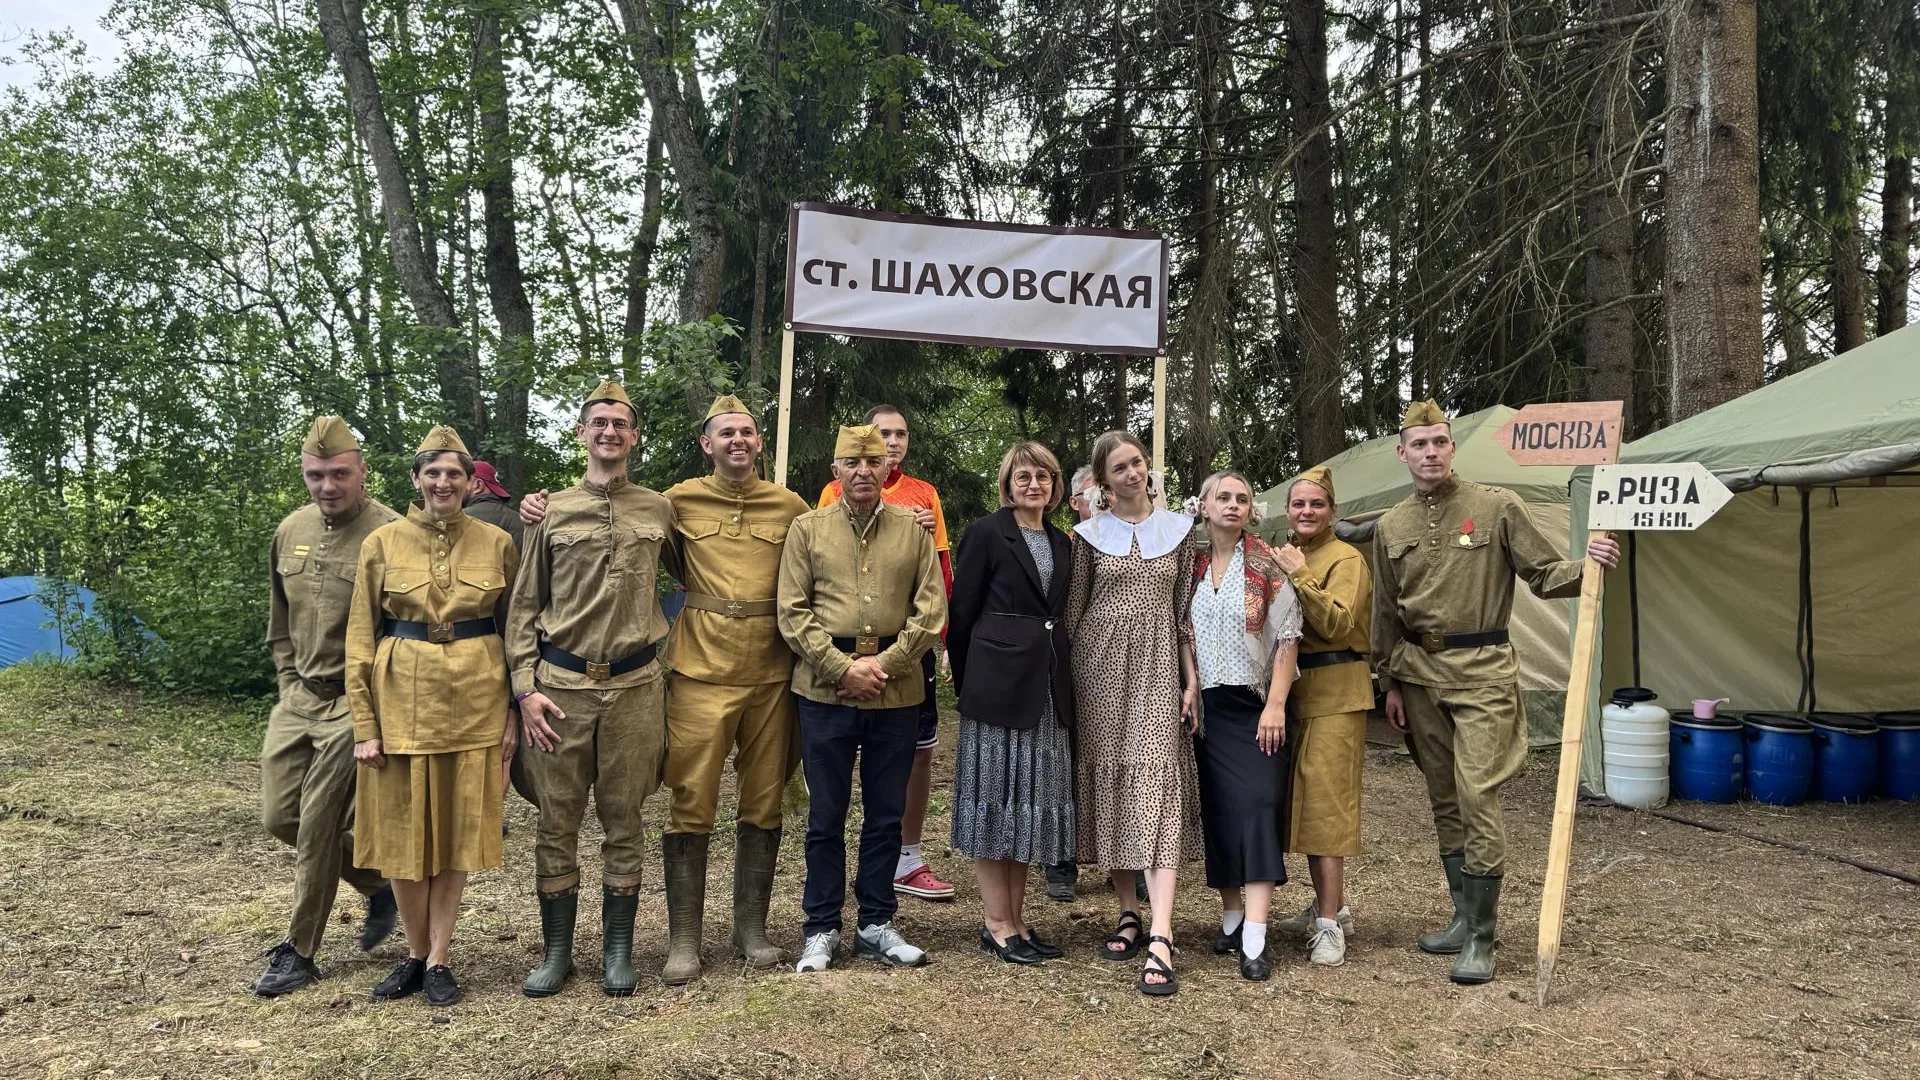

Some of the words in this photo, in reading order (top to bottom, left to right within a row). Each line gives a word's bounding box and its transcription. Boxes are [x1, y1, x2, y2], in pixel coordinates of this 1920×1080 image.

[871, 257, 1153, 310] ШАХОВСКАЯ
[1511, 420, 1607, 450] МОСКВА
[1630, 511, 1654, 528] 15
